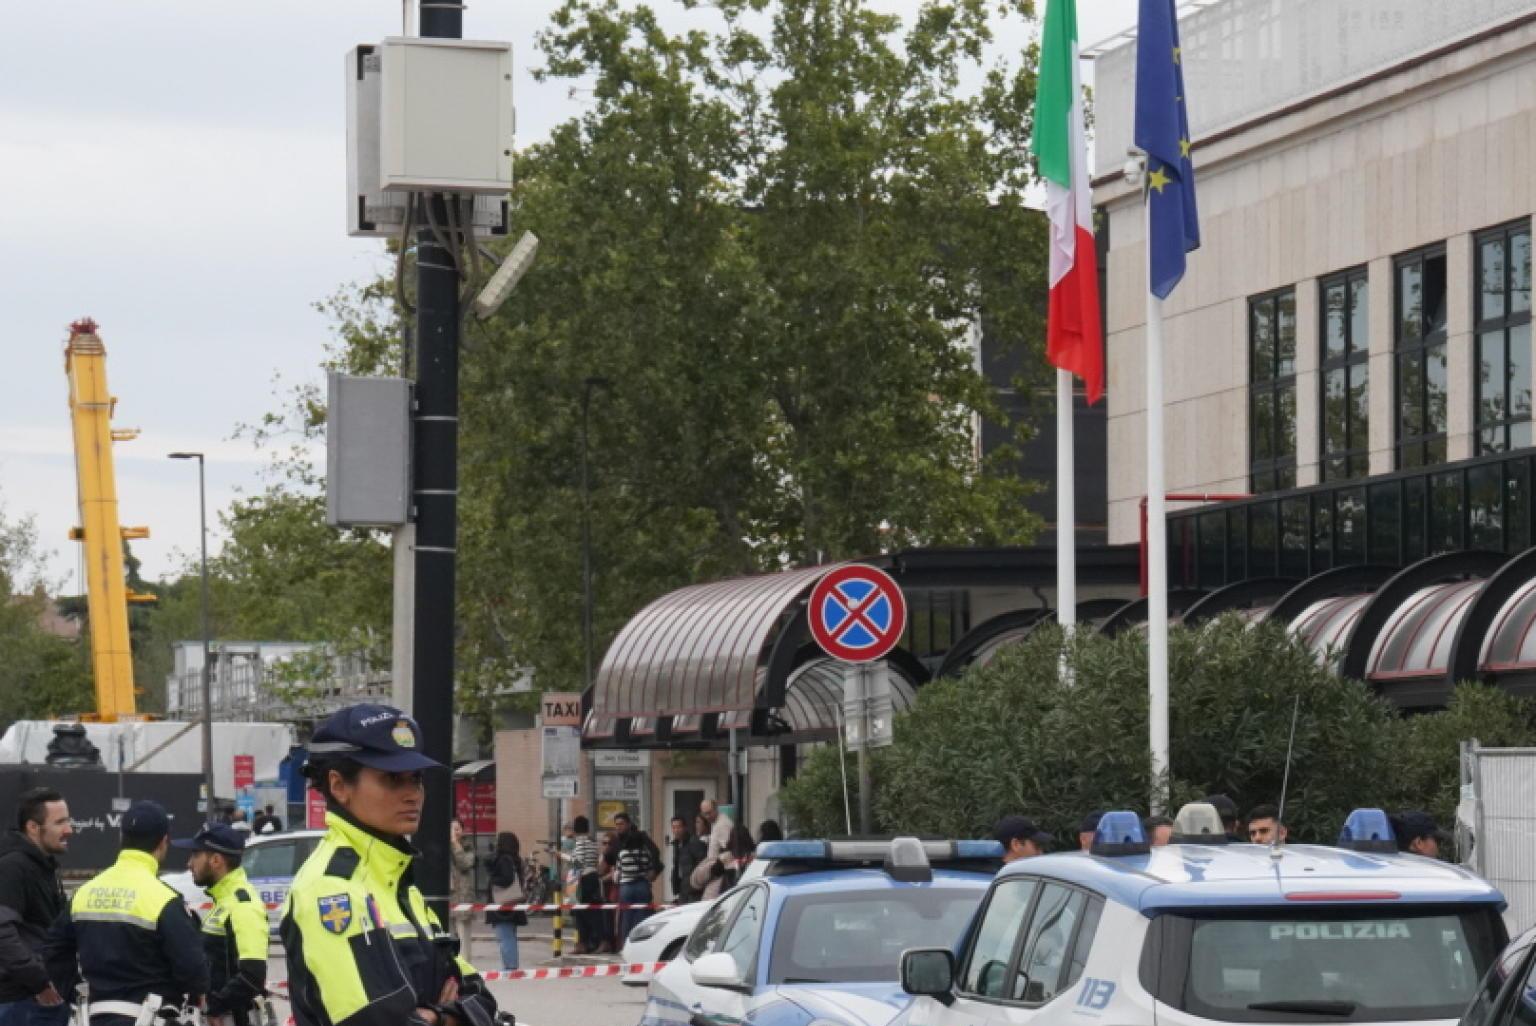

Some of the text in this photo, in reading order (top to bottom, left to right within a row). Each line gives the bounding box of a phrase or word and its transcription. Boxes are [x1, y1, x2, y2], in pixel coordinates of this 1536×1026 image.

[545, 702, 579, 718] TAXI
[88, 887, 137, 899] POLIZIA
[87, 899, 134, 910] LOCALE
[1270, 922, 1410, 940] POLIZIA
[1076, 977, 1117, 1010] 113
